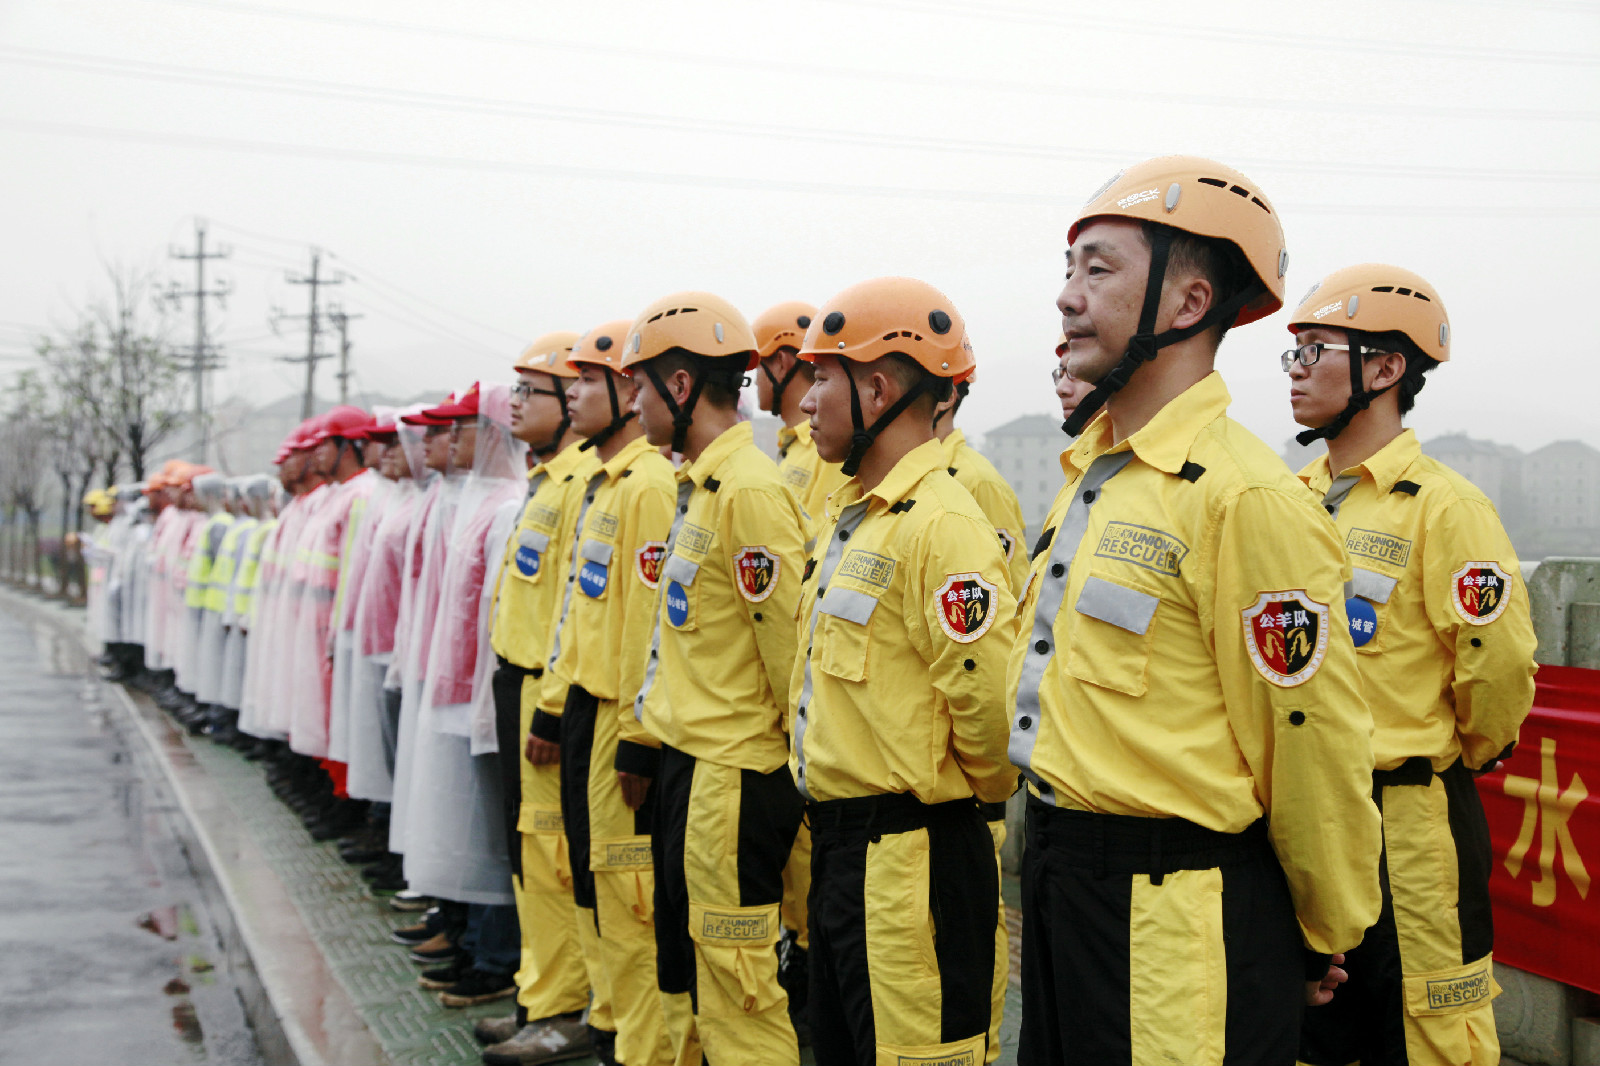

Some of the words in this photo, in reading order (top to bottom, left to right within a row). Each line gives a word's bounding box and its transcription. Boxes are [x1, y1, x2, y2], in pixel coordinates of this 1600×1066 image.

[1117, 188, 1160, 206] ROCK
[1101, 538, 1165, 567] RESCUE
[1346, 540, 1400, 560] RESCUE
[1463, 575, 1499, 587] 公羊队
[946, 586, 984, 602] 公羊队
[1260, 609, 1311, 629] 公羊队
[1348, 617, 1375, 634] 城管
[1503, 737, 1592, 908] 水
[706, 924, 758, 937] RESCUE
[1432, 985, 1485, 1005] RESCUE
